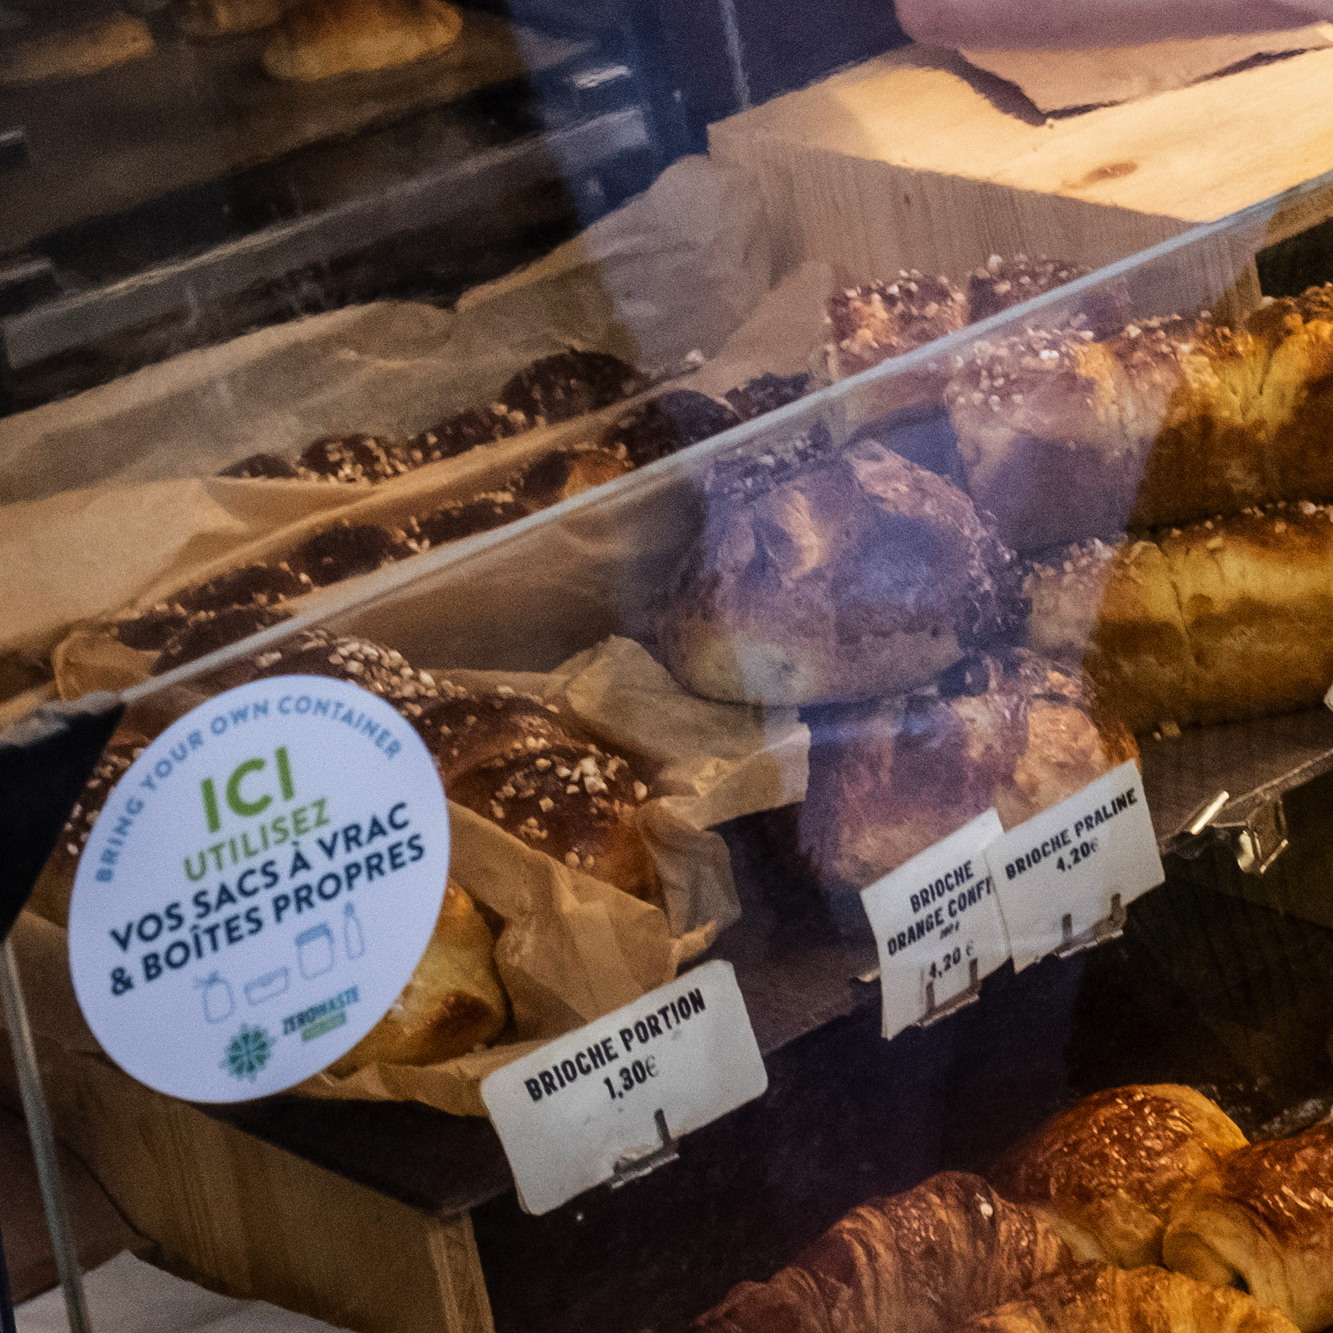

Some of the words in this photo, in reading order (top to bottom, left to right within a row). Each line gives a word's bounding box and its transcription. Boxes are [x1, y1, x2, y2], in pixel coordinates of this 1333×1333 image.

[96, 797, 145, 884] BRING
[140, 731, 205, 792] YOUR
[209, 699, 269, 736] OWN
[277, 694, 404, 760] CONTAINER
[202, 746, 294, 834] ICI
[1005, 829, 1073, 880] BRIOCHE
[1075, 787, 1138, 838] PRALINE
[109, 901, 185, 953] VOS
[191, 860, 279, 919] SACS
[289, 840, 312, 879] À
[316, 801, 411, 861] VRAC
[183, 797, 331, 883] UTILISEZ
[110, 966, 136, 997] &
[141, 906, 264, 984] BOÎTES
[271, 832, 426, 924] PROPRES
[886, 906, 945, 957] ORANGE
[947, 875, 994, 919] CONFI
[909, 859, 975, 915] BRIOCHE
[524, 1037, 619, 1103] BRIOCHE
[619, 987, 706, 1052] PORTION
